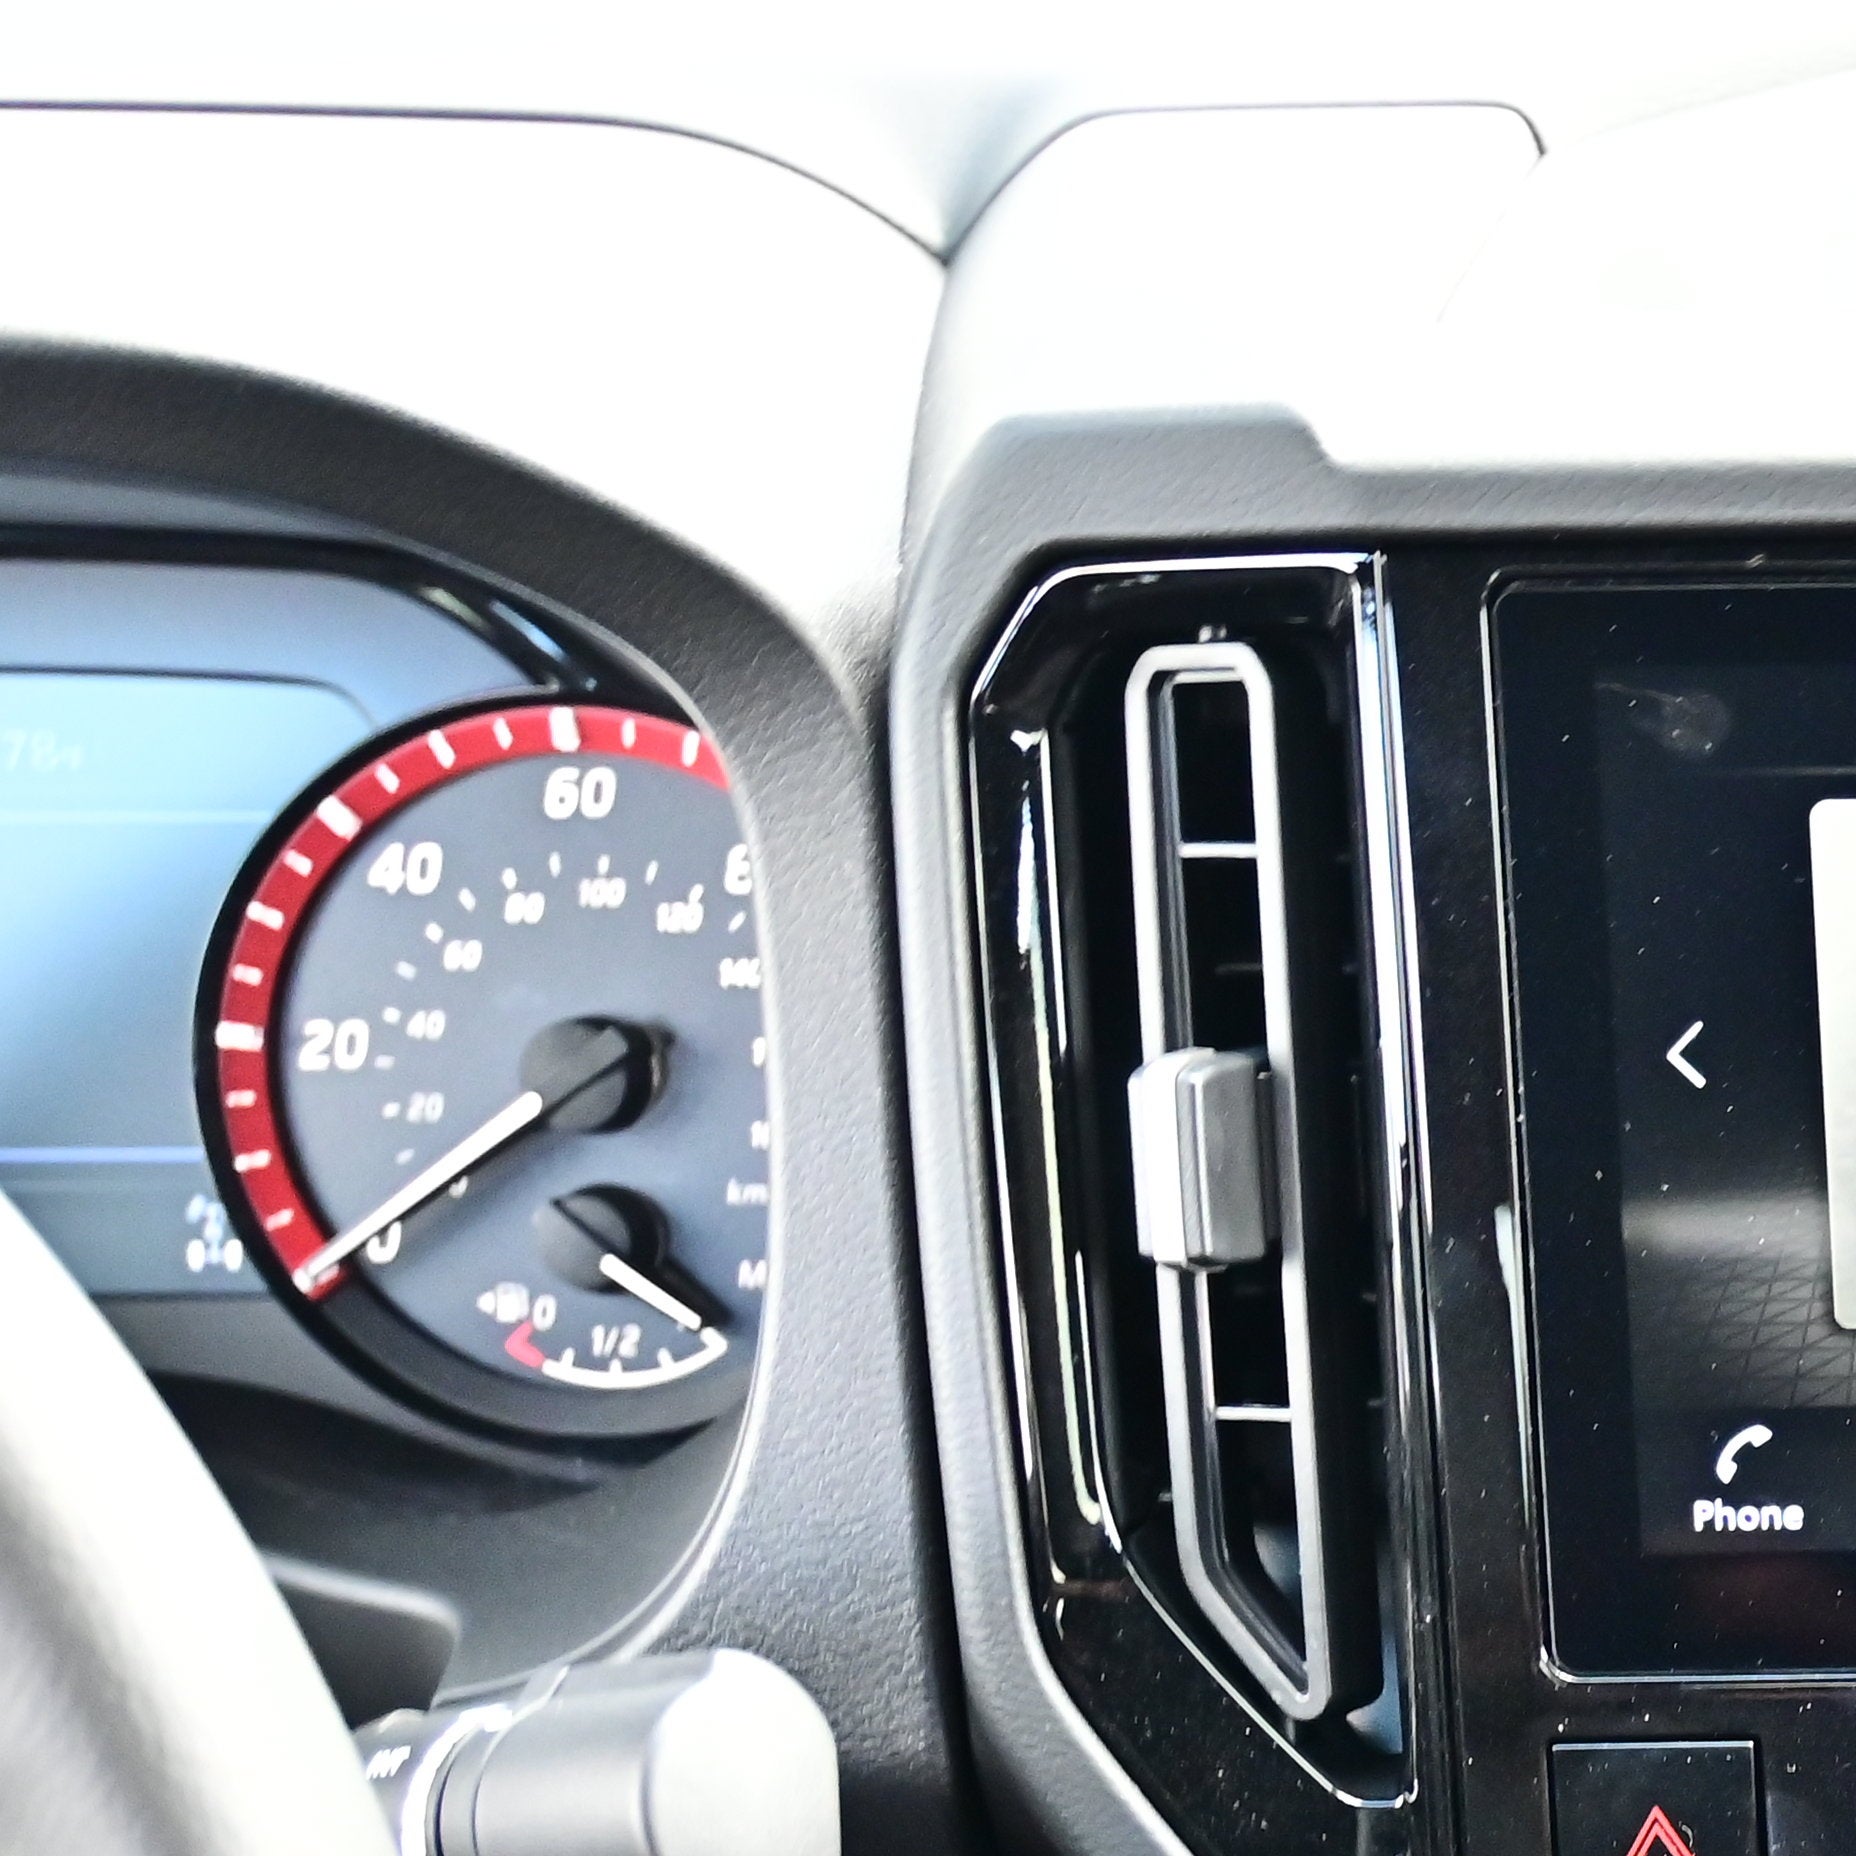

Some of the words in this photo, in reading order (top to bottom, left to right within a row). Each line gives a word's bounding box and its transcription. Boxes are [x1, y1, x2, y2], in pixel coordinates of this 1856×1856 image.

[543, 767, 617, 820] 60
[368, 841, 443, 895] 40
[299, 1019, 369, 1071] 20
[533, 1295, 556, 1329] 0
[591, 1325, 640, 1355] 1/2
[1693, 1498, 1804, 1532] Phone
